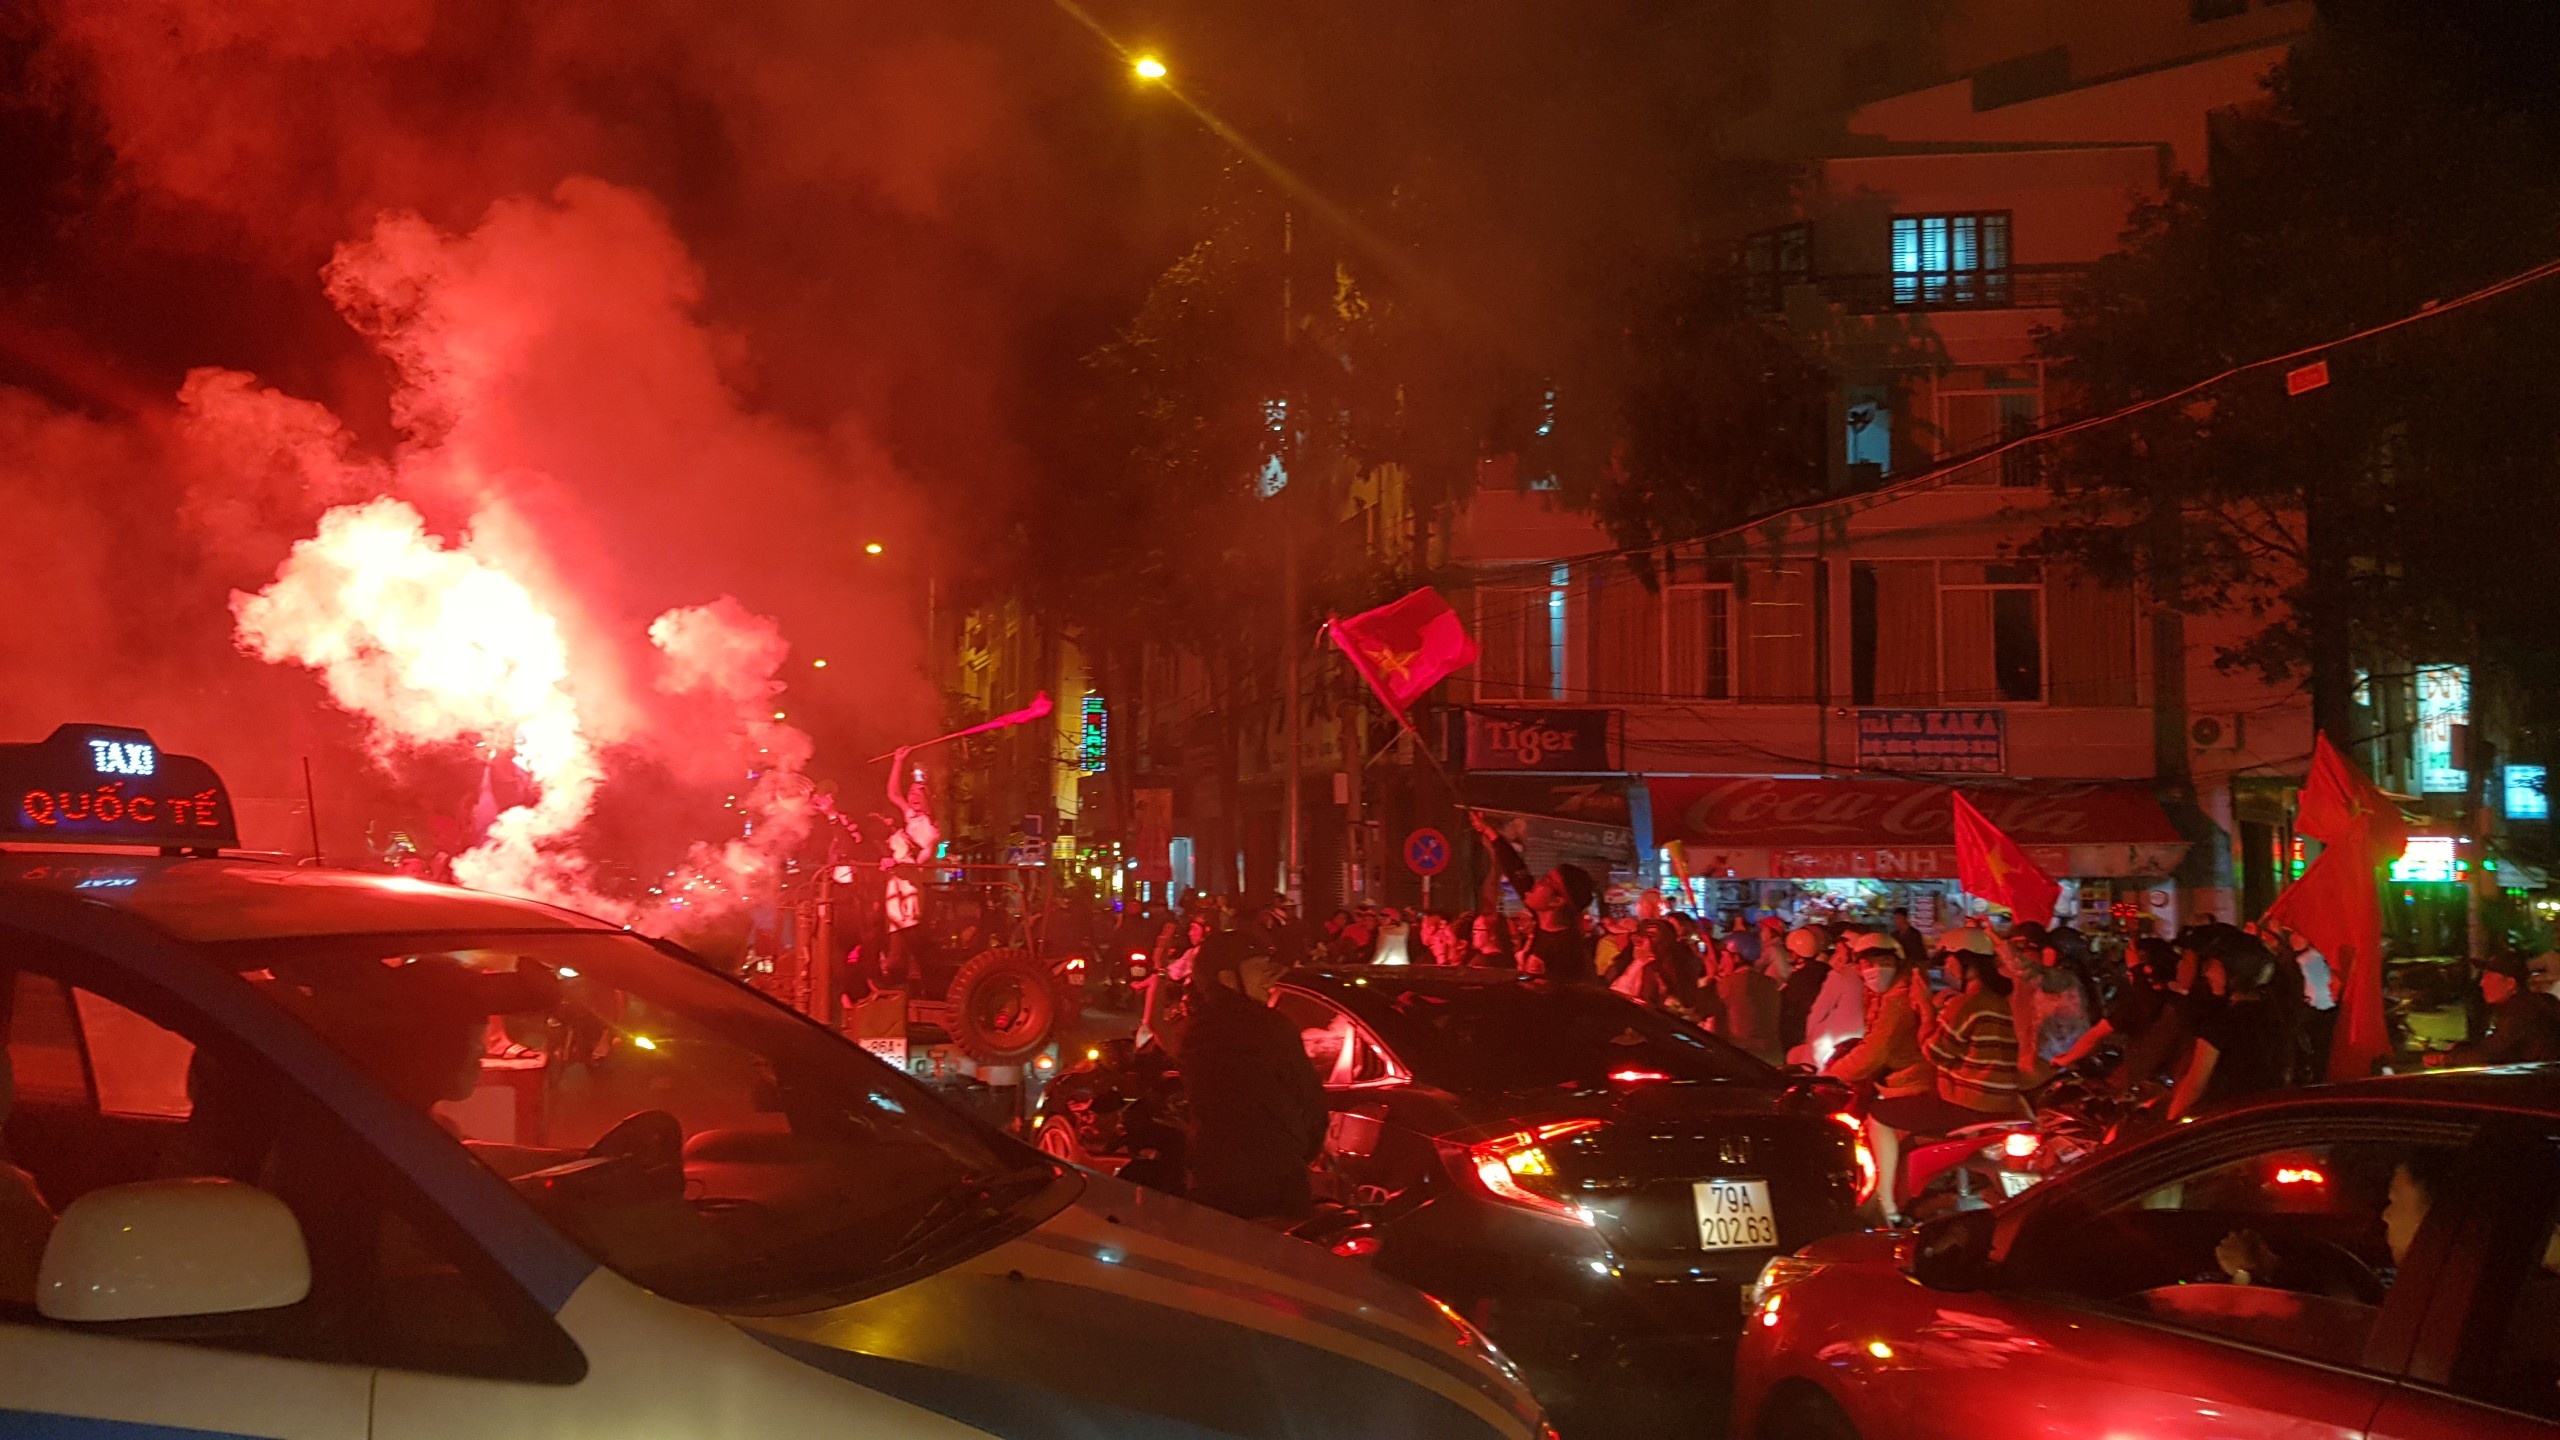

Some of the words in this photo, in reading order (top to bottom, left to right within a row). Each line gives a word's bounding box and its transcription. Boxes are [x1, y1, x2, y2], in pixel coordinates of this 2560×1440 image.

[89, 740, 155, 776] TAXI
[1484, 718, 1578, 765] Tiger
[23, 781, 157, 826] QUỐC
[167, 788, 220, 827] TẾ
[1686, 776, 2098, 836] Coca-Cla
[1710, 1185, 1755, 1215] 79A
